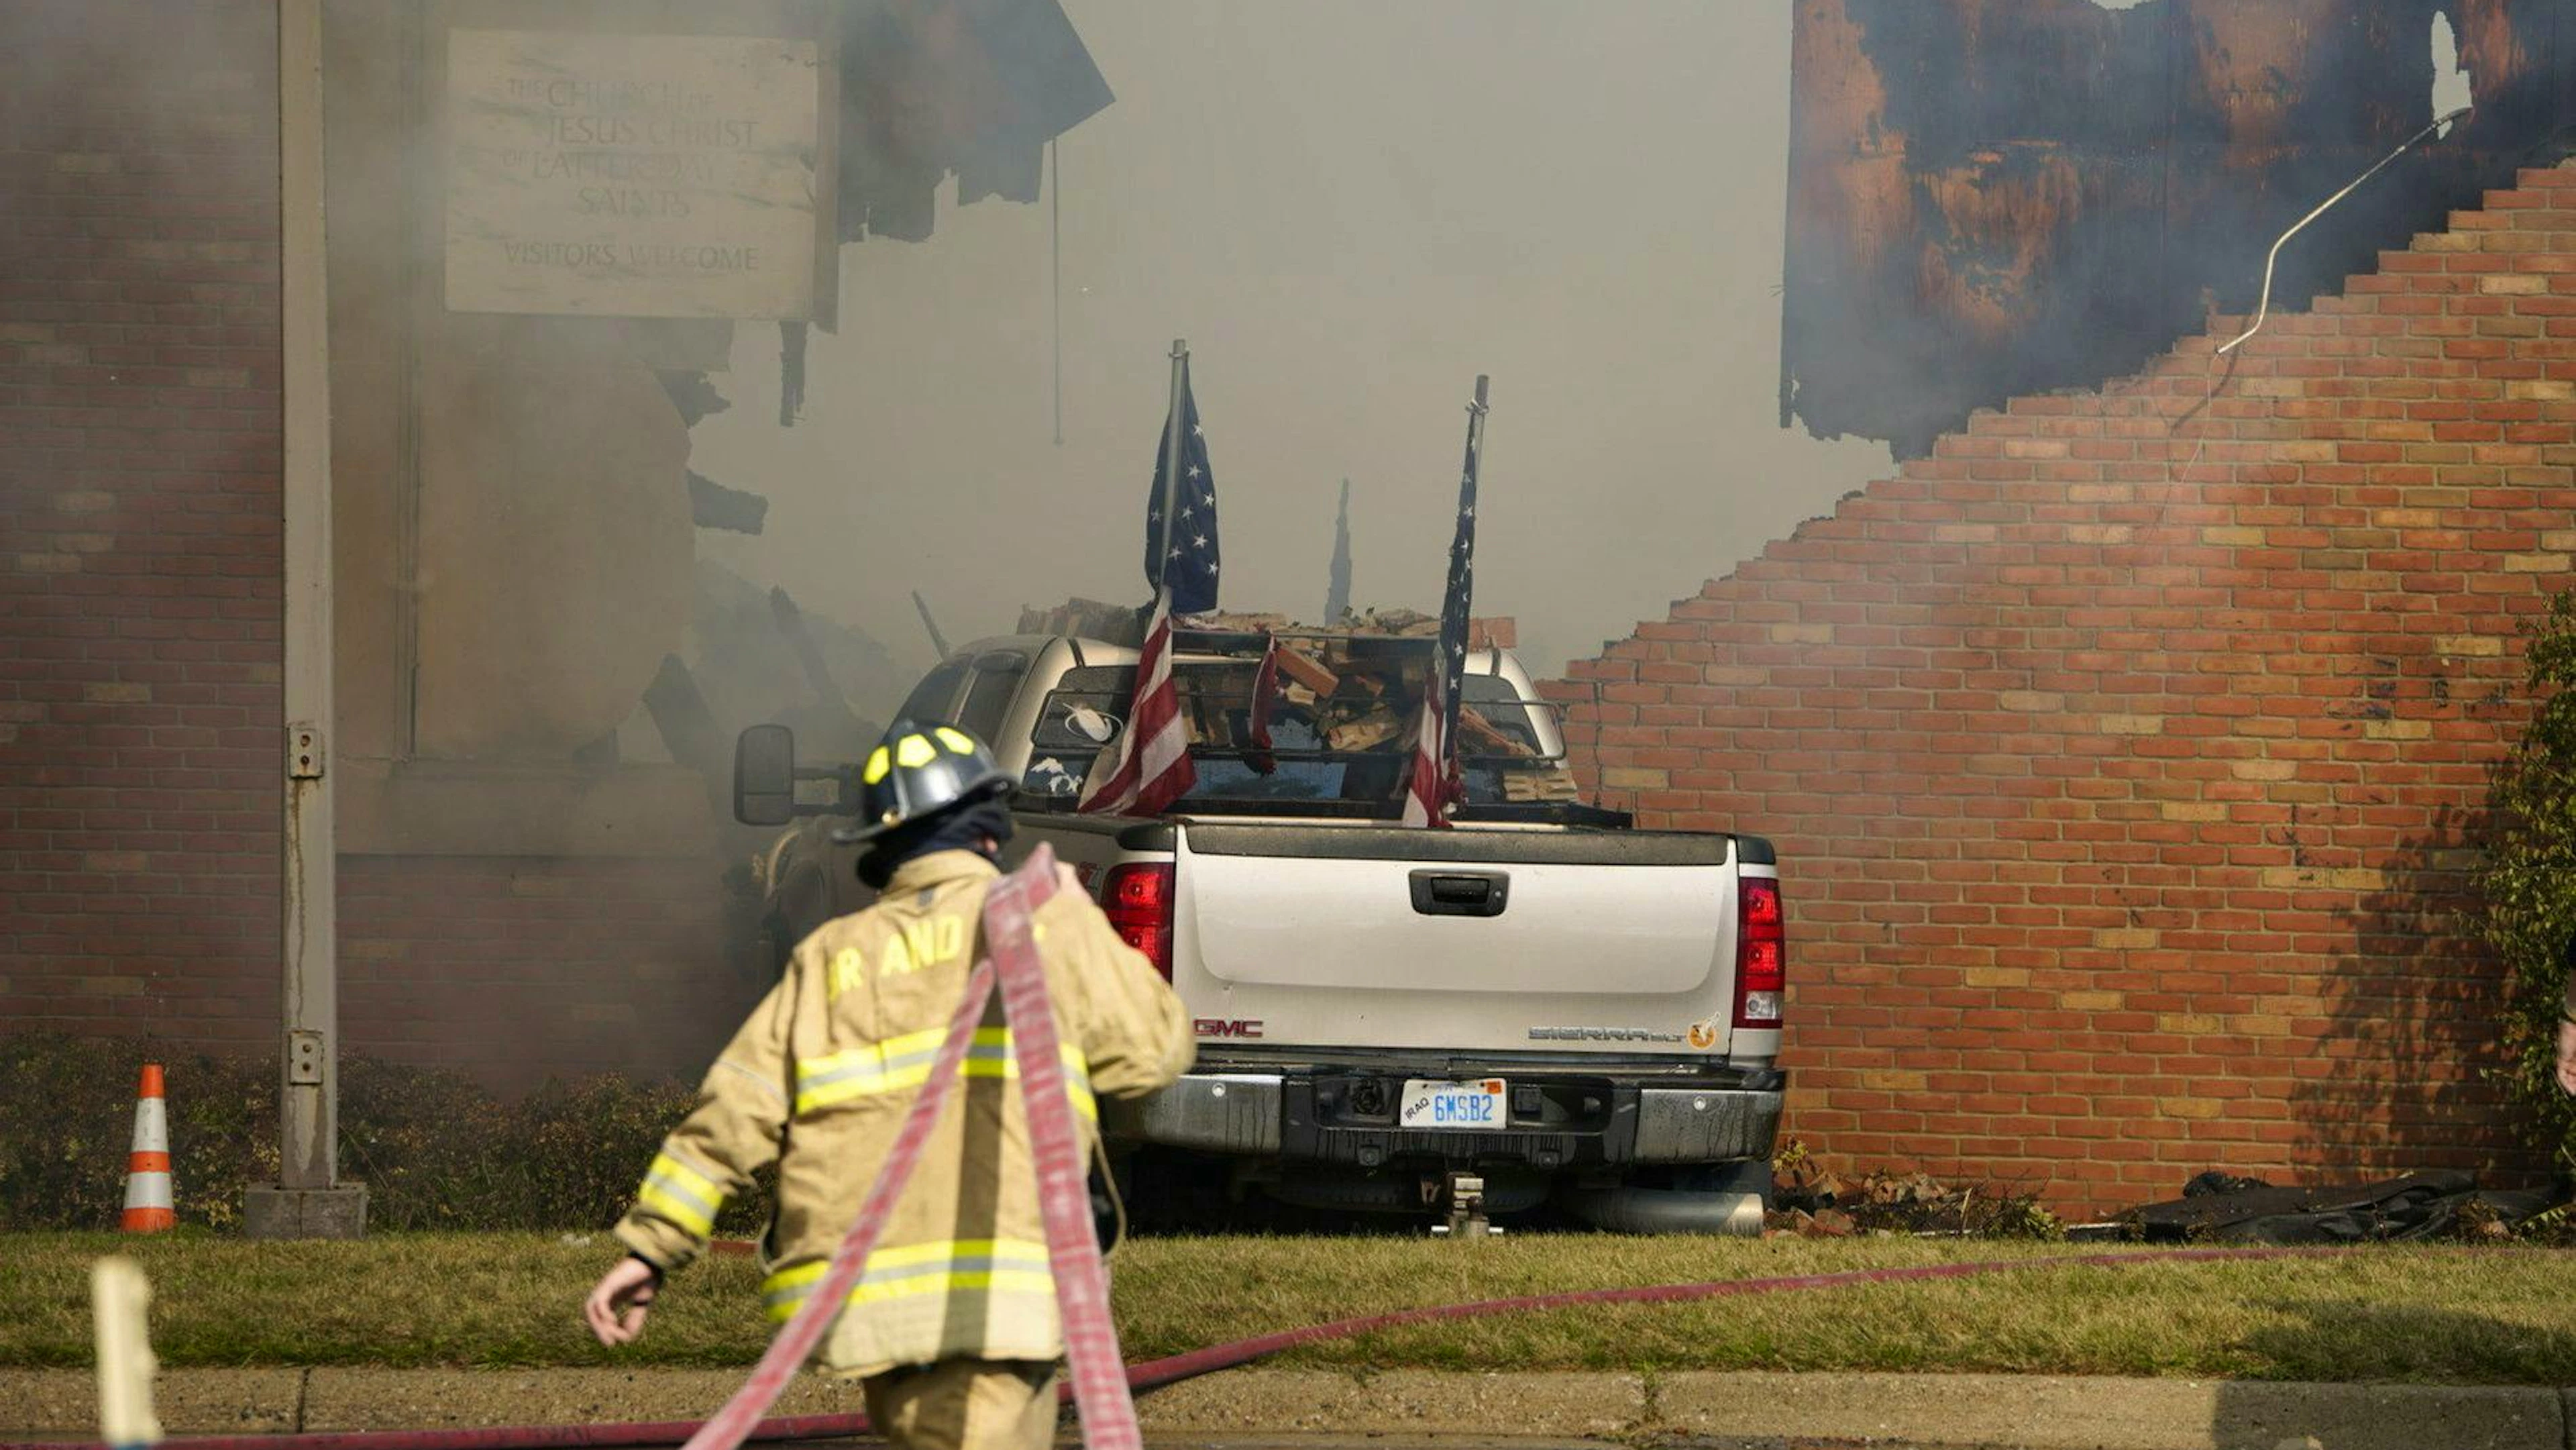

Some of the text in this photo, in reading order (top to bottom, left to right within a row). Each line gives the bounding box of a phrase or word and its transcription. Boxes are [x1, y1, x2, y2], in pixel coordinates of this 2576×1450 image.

[508, 78, 545, 97] THE
[546, 115, 759, 148] JESUS CHRIST
[577, 187, 691, 217] SAINTS
[504, 242, 759, 271] VISITORS WELCOME
[1193, 1017, 1265, 1038] GMC
[1528, 1026, 1650, 1041] SIERRA
[1405, 1096, 1430, 1121] IRAQ
